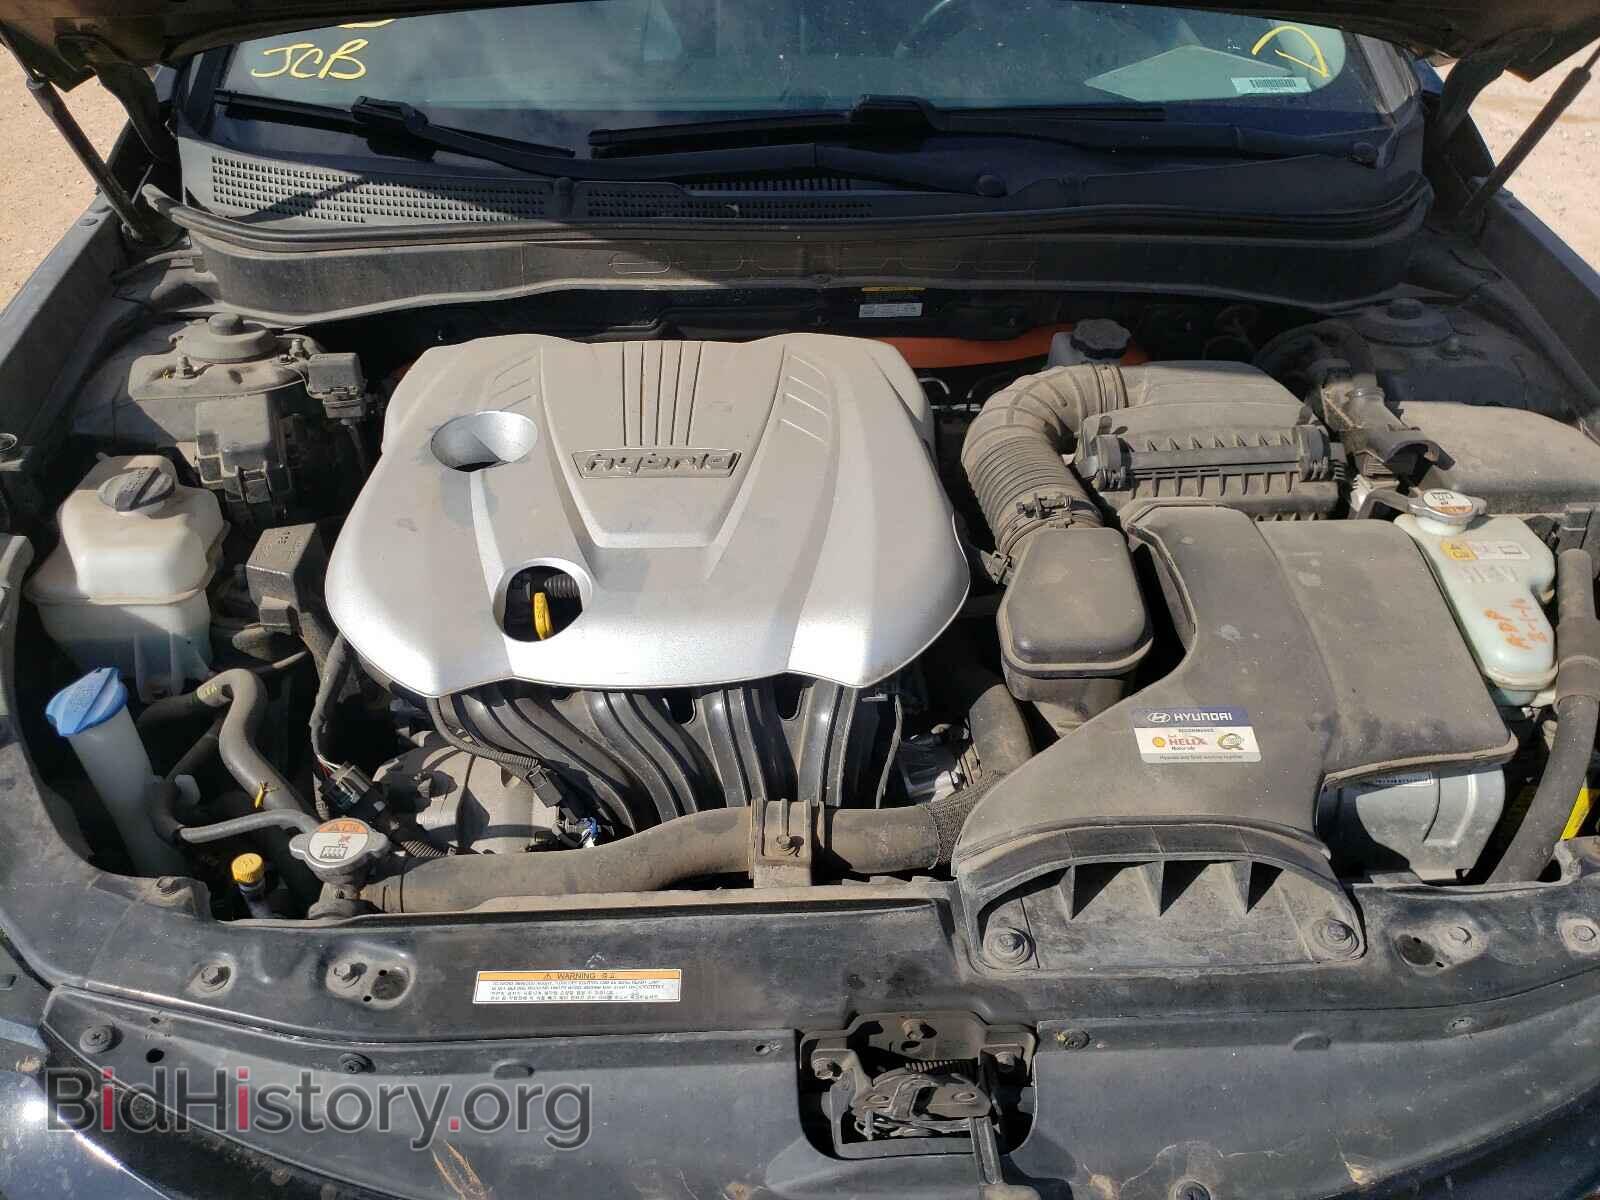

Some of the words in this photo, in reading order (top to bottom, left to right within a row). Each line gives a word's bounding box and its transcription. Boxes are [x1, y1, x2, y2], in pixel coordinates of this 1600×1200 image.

[250, 38, 368, 80] JCB
[1173, 711, 1233, 721] HYUNDAI
[1168, 735, 1208, 747] HELIX
[557, 972, 596, 980] WARNING
